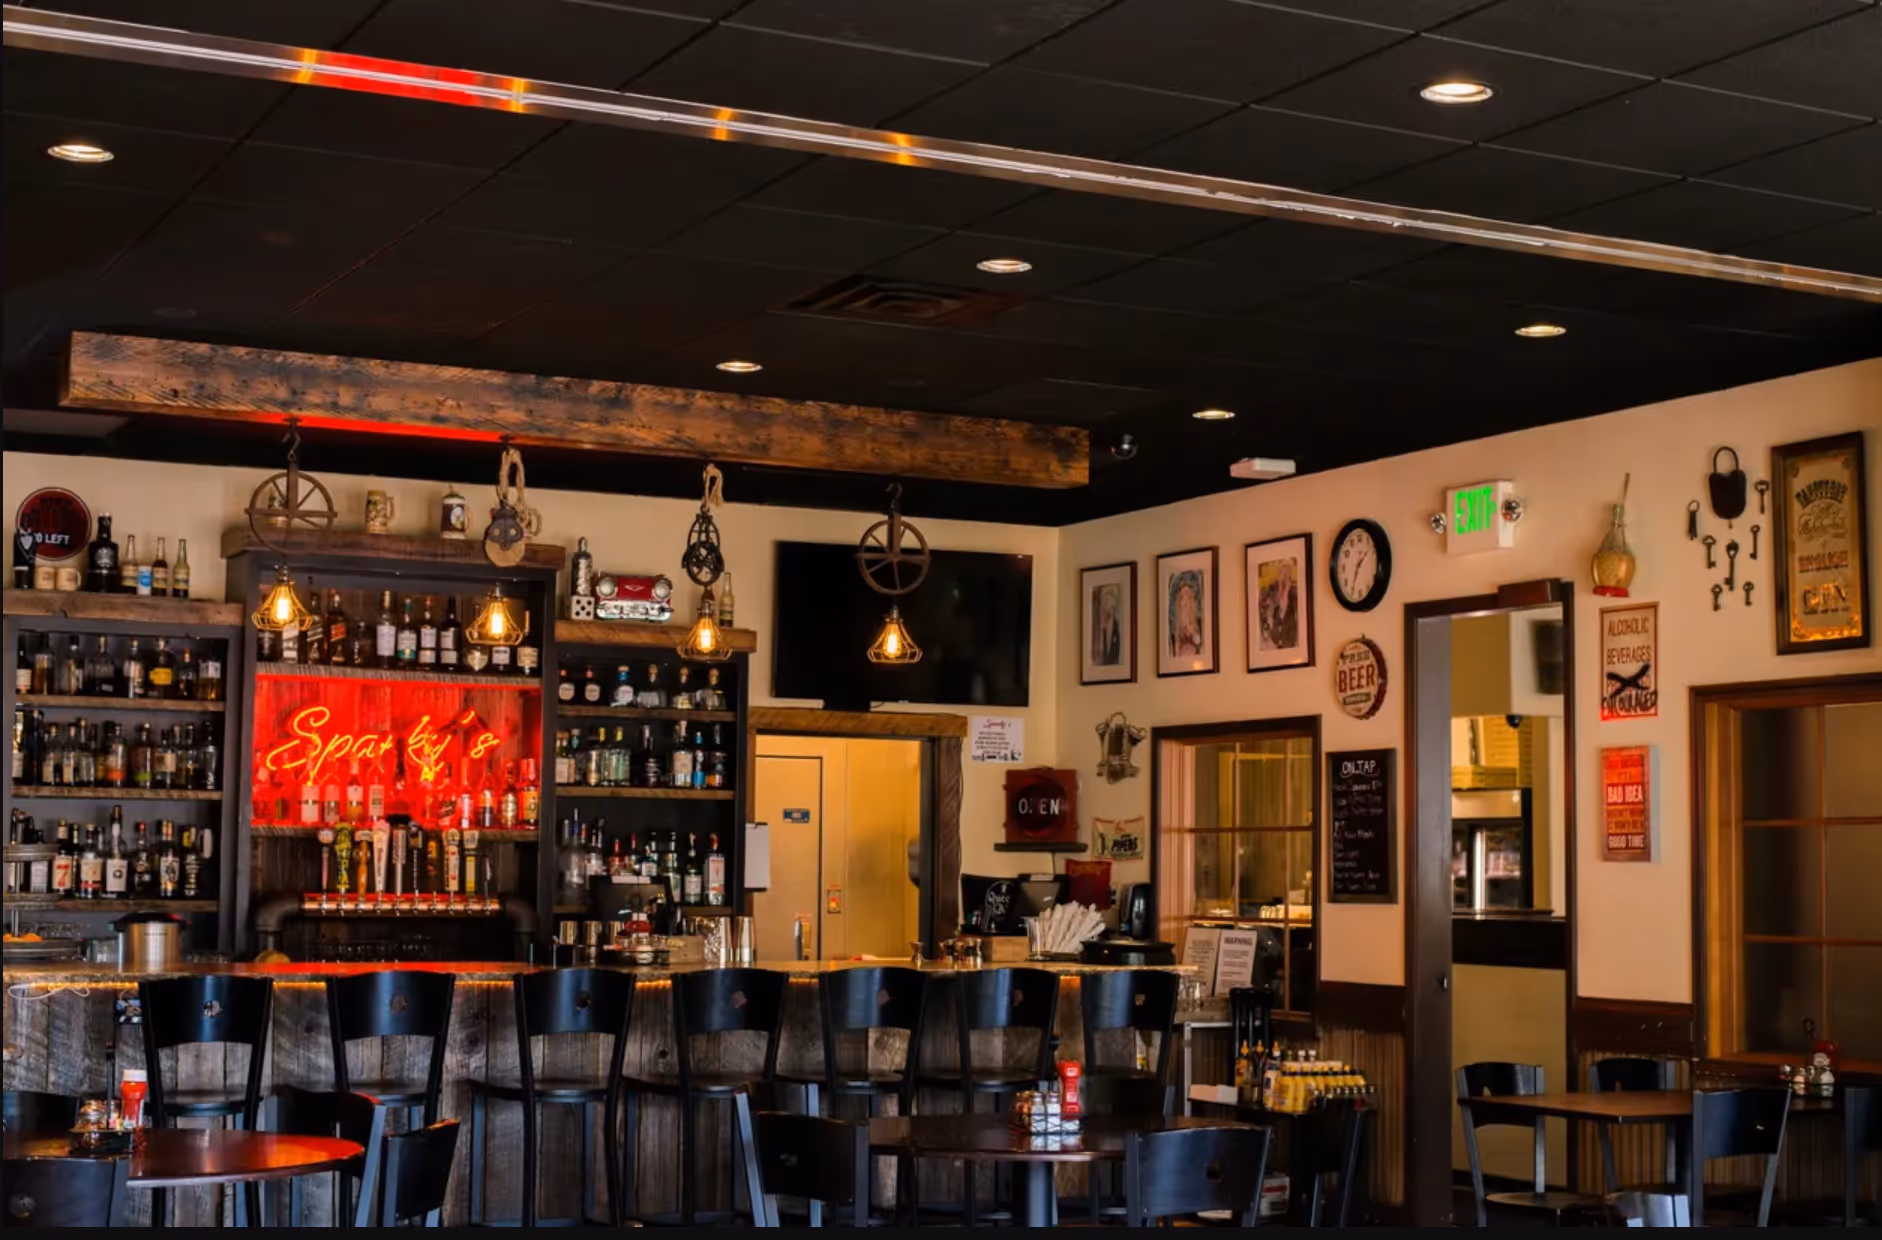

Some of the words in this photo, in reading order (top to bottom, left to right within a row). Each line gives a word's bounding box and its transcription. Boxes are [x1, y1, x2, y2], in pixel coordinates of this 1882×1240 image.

[1455, 486, 1492, 534] EXIT
[45, 533, 70, 545] LEFT
[1608, 618, 1650, 637] ALCOHOLIC
[1606, 645, 1651, 666] BEVERAGES
[1339, 664, 1375, 693] BEER
[266, 706, 499, 786] Sparky's
[1357, 760, 1376, 774] TAP
[1607, 785, 1624, 803] BAD
[1625, 784, 1643, 803] IDEA
[1018, 798, 1060, 815] OEN
[1608, 835, 1627, 849] GOOD
[1628, 834, 1645, 849] TIME
